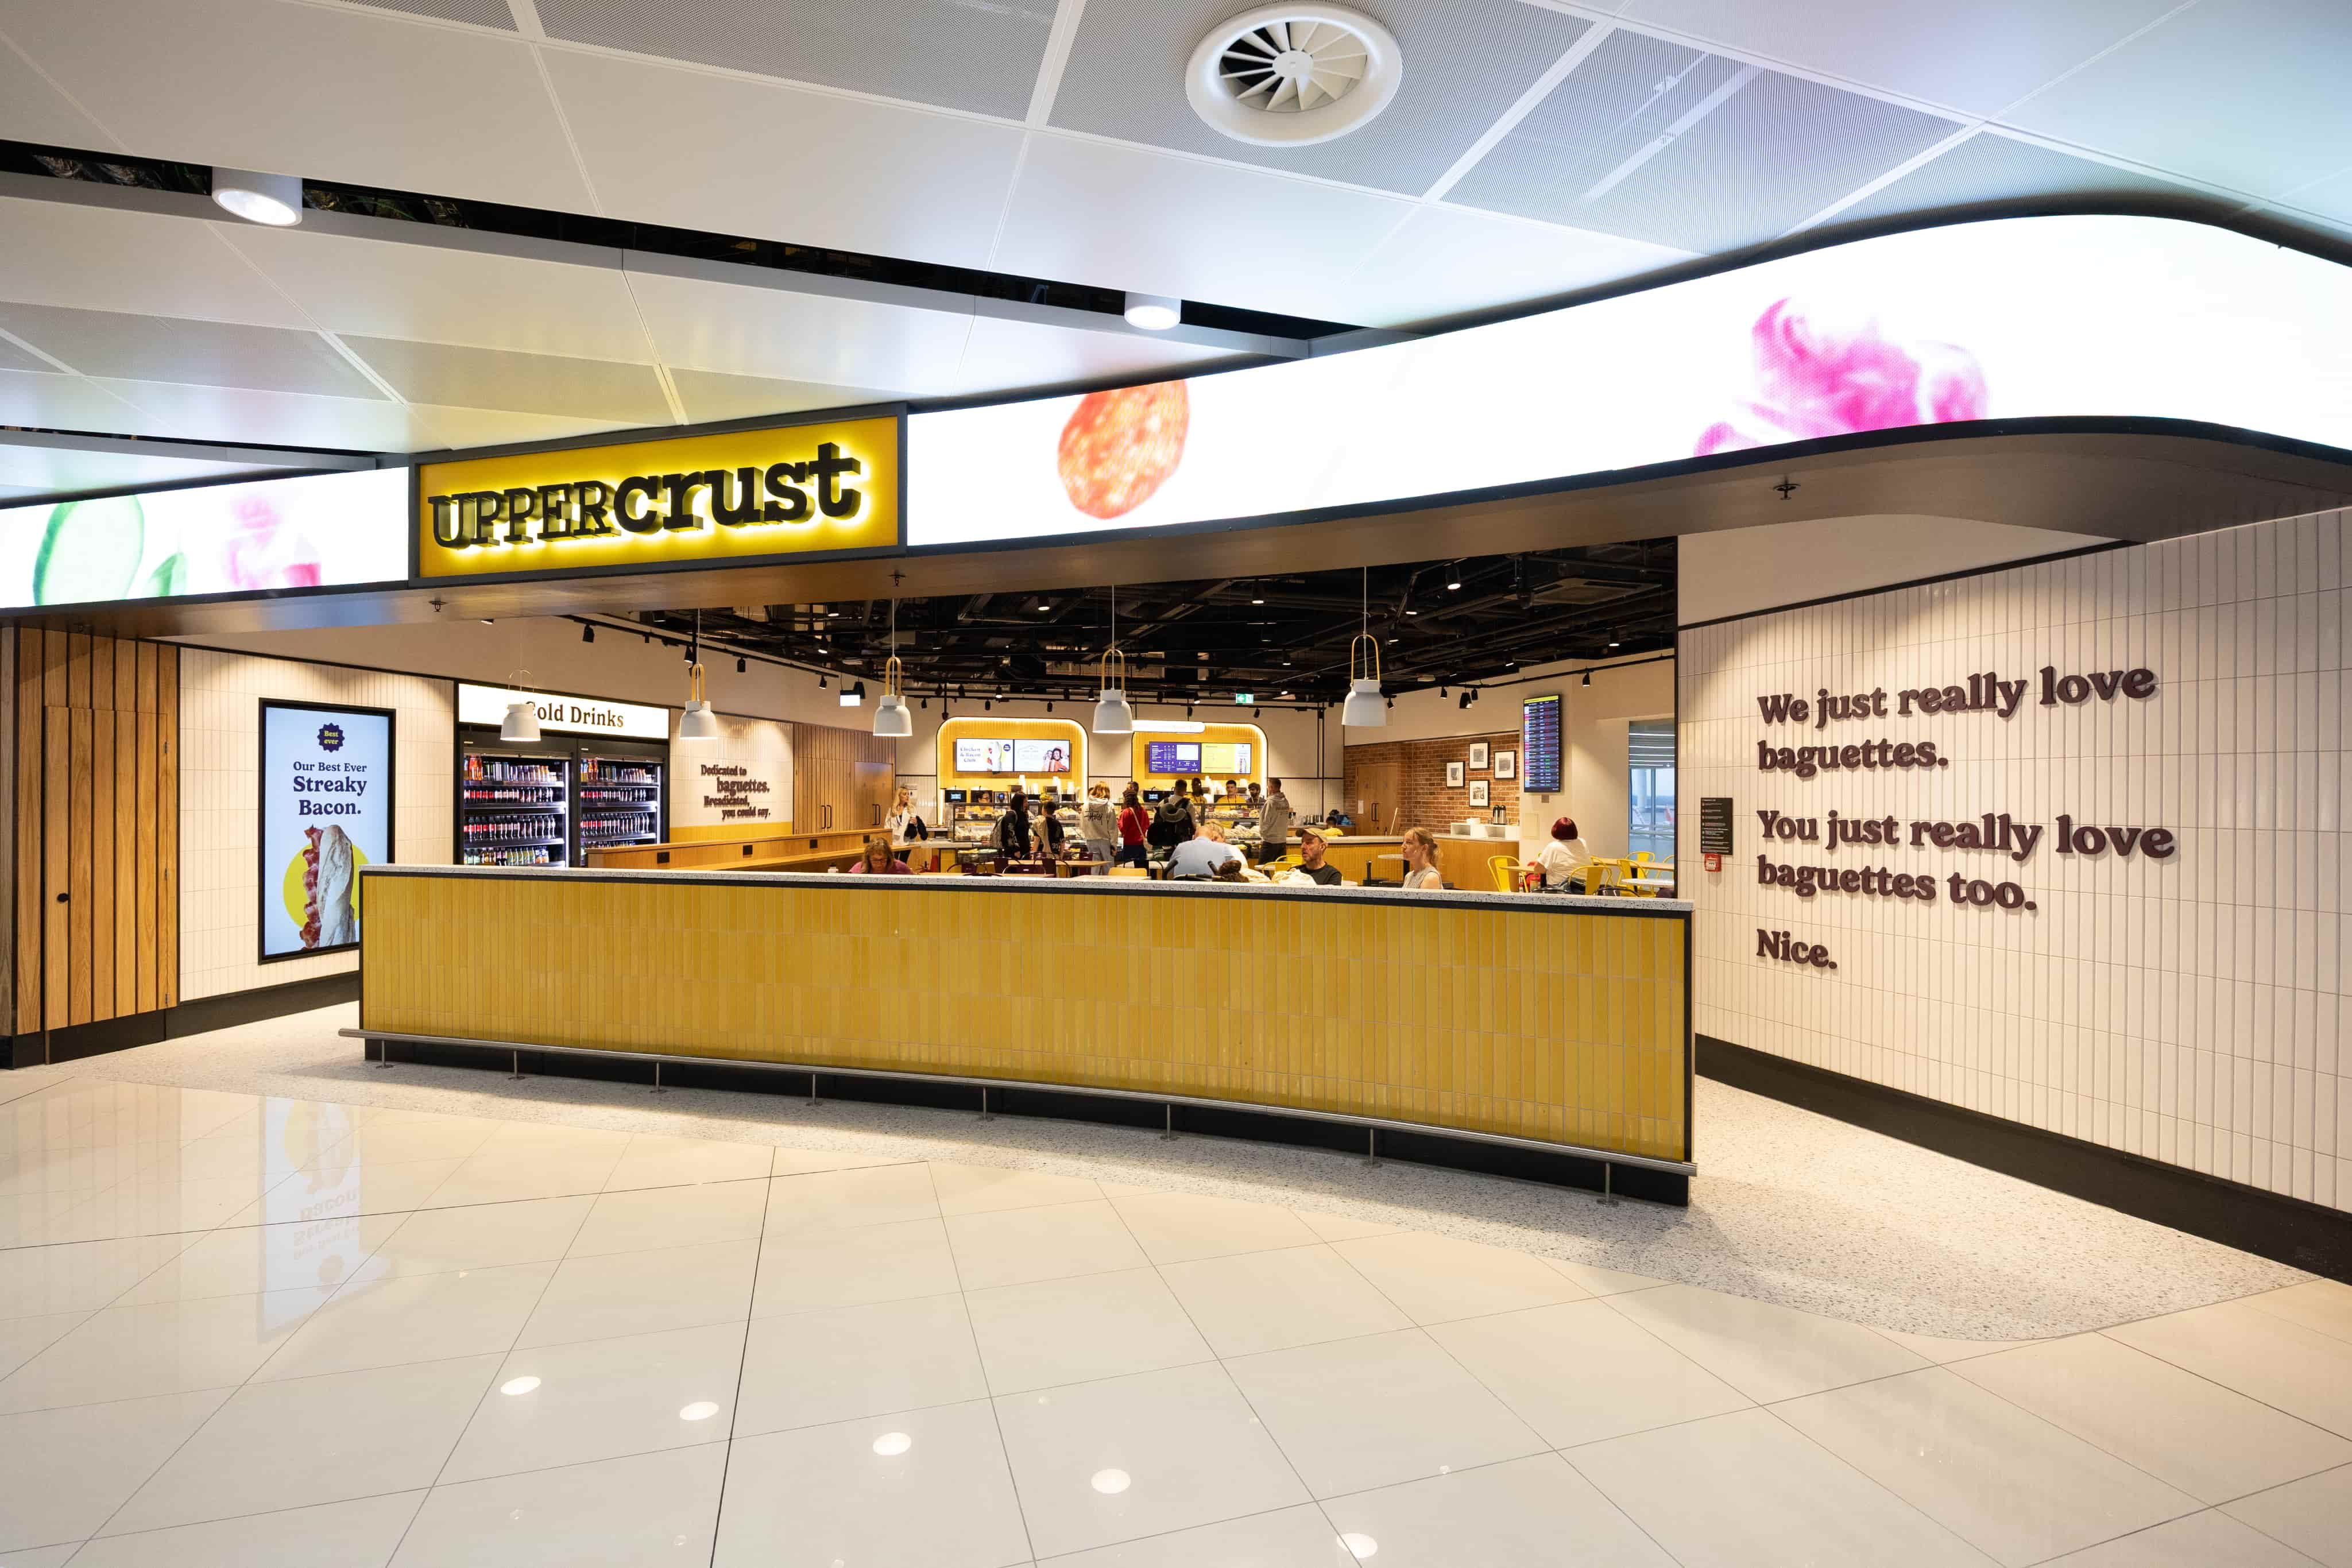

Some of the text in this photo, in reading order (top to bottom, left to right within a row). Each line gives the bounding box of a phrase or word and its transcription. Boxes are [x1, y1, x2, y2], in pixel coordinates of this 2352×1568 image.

[1758, 666, 2156, 729] We just really love
[570, 705, 624, 729] Drinks
[293, 761, 367, 772] Our Best Ever
[1758, 738, 1948, 777] baguettes.
[701, 764, 747, 776] Dedicated to
[293, 776, 368, 796] Streaky
[717, 776, 770, 796] baguettes.
[299, 799, 361, 815] Bacon.
[722, 809, 736, 821] you
[737, 806, 756, 818] could
[1757, 810, 1819, 841] You
[1826, 810, 1900, 850] just
[1910, 813, 2042, 861] really
[2056, 814, 2175, 858] love
[1757, 854, 2037, 911] baguettes too.
[1757, 929, 1838, 969] Nice.
